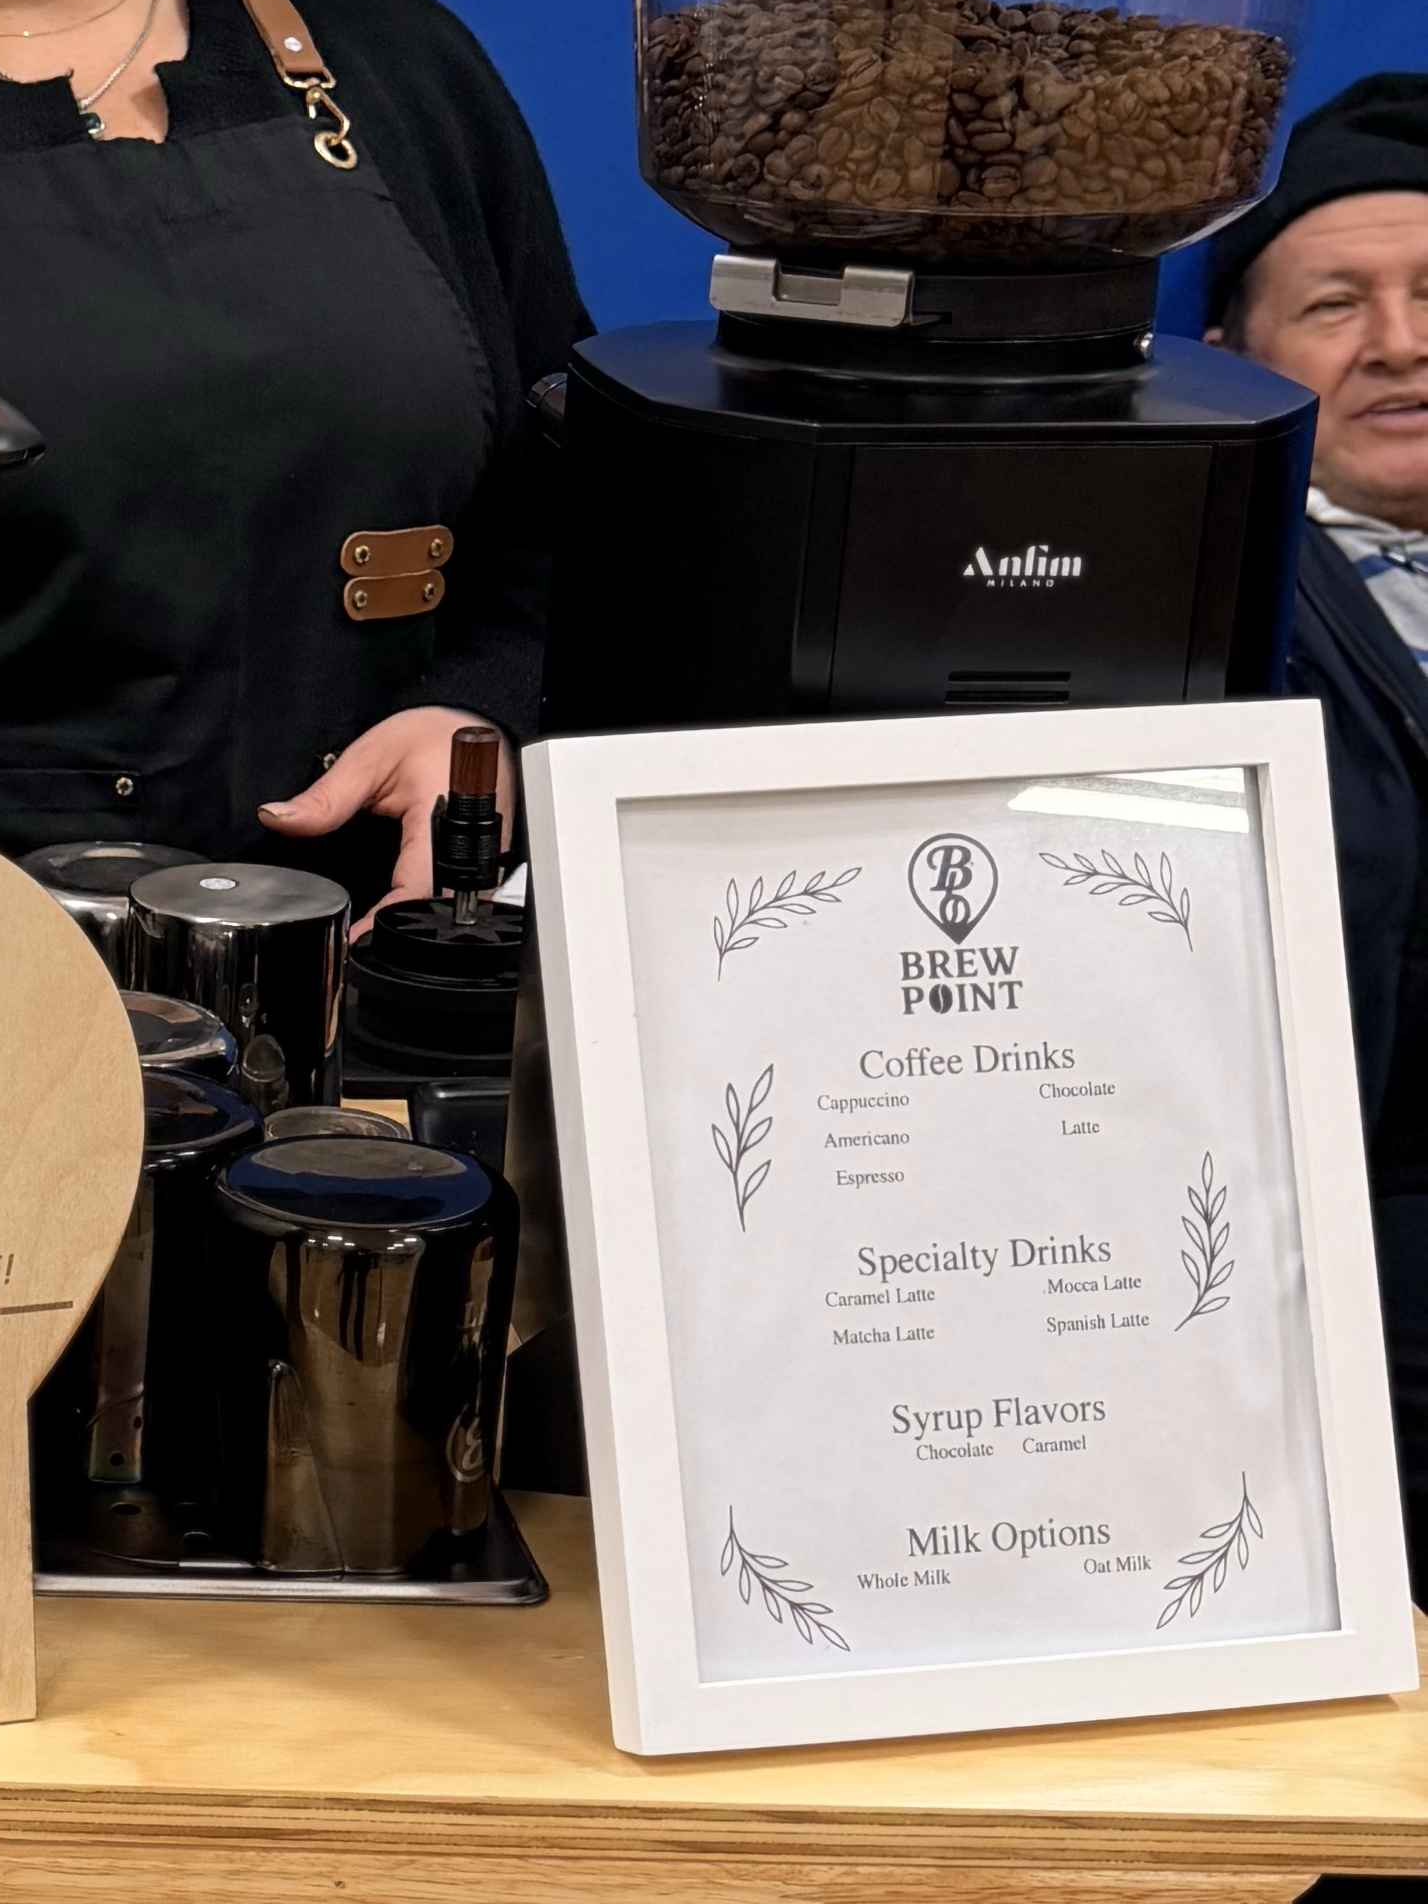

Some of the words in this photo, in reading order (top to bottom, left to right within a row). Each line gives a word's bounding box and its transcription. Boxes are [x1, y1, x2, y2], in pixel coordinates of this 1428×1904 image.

[963, 544, 1082, 577] Anfim
[986, 579, 1055, 588] MILANO
[899, 946, 1020, 981] BREW
[901, 980, 1023, 1015] POINT
[859, 1046, 964, 1080] Coffee
[973, 1041, 1075, 1074] Drinks
[1038, 1081, 1116, 1099] Chocolate
[817, 1094, 910, 1114] Cappuccino
[1061, 1120, 1100, 1136] Latte
[824, 1132, 910, 1149] Americano
[836, 1170, 905, 1189] Espresso
[858, 1241, 999, 1282] Specialty
[1009, 1234, 1111, 1267] Drinks
[1047, 1278, 1099, 1295] Mocca
[1103, 1275, 1142, 1291] Latte
[825, 1289, 891, 1308] Caramel
[896, 1287, 936, 1304] Latte
[1046, 1314, 1106, 1336] Spanish
[1110, 1313, 1150, 1329] Latte
[833, 1327, 892, 1346] Matcha
[895, 1325, 935, 1342] Latte
[892, 1404, 983, 1441] Syrup
[992, 1396, 1106, 1428] Flavors
[916, 1442, 994, 1461] Chocolate
[1022, 1434, 1087, 1454] Caramel
[907, 1524, 982, 1557] Milk
[991, 1517, 1111, 1559] Options
[1083, 1558, 1112, 1575] Oat
[1115, 1555, 1152, 1573] Milk
[856, 1572, 909, 1590] Whole
[913, 1569, 952, 1587] Milk
